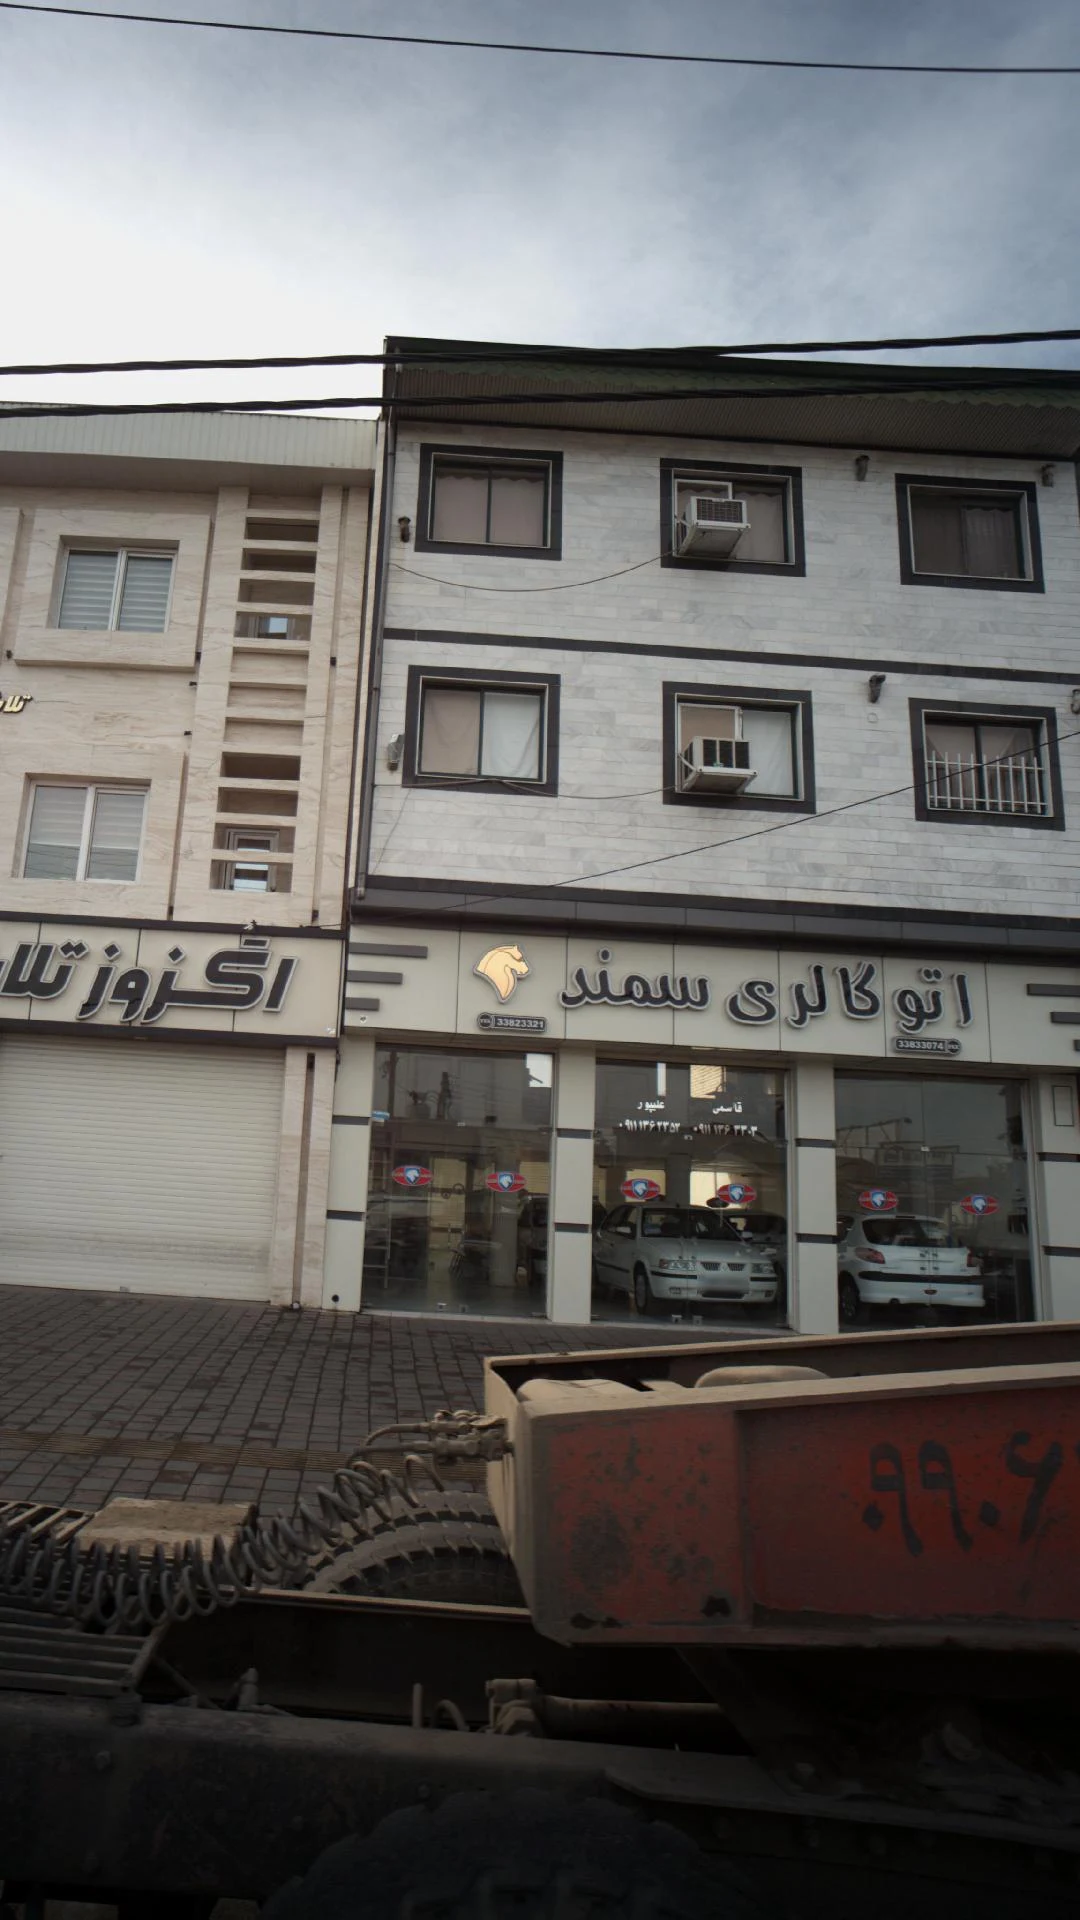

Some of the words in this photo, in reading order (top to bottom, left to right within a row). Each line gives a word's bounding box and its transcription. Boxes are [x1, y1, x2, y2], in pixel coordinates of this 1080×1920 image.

[0, 940, 89, 999] تلا
[76, 937, 299, 1024] اگزوز
[558, 946, 710, 1009] سمند
[725, 961, 881, 1029] گالری
[894, 967, 973, 1034] اتو
[898, 1040, 944, 1050] 33833074
[712, 1101, 742, 1114] قاسمی
